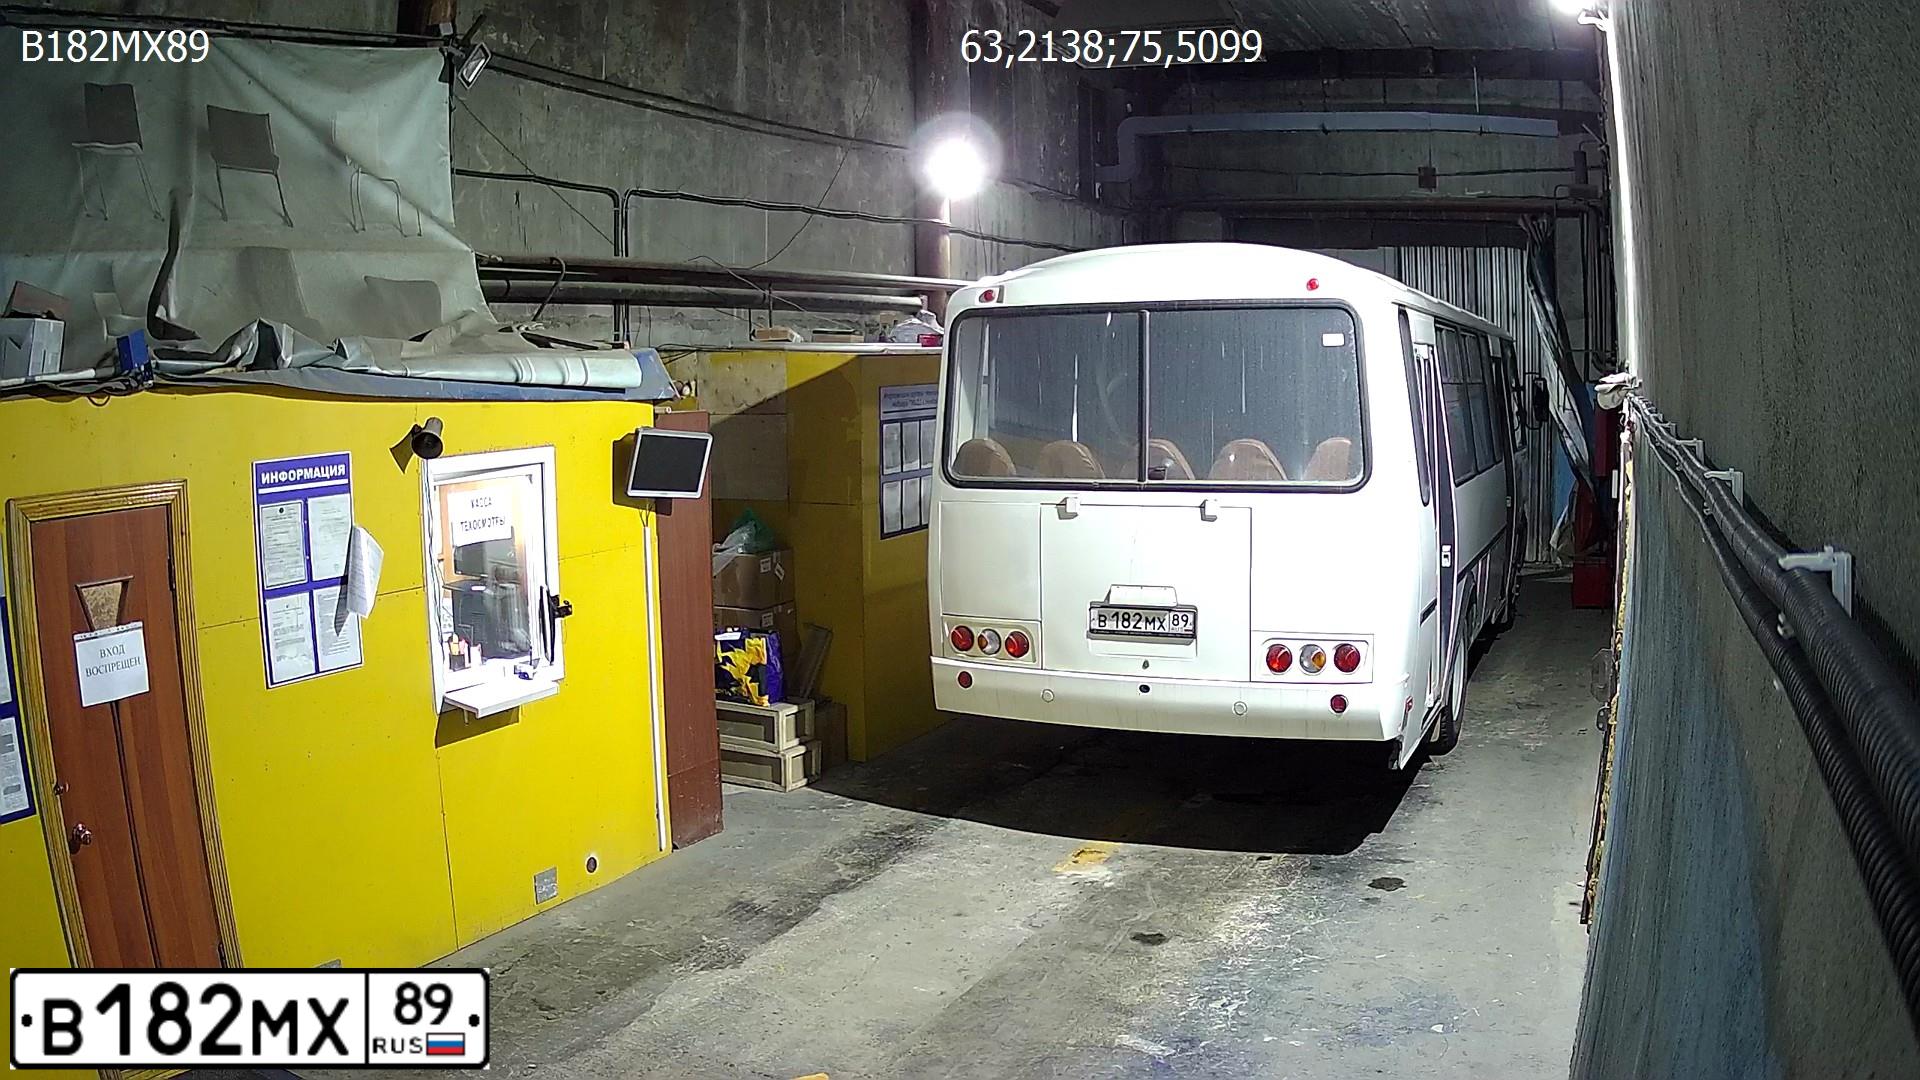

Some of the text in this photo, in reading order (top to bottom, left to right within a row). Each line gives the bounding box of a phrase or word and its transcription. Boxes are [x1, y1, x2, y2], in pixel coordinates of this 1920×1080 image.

[261, 464, 346, 484] ИНФОРМАЦИЯ
[470, 497, 492, 508] КАССА
[1171, 613, 1189, 627] 89
[99, 644, 126, 659] ВХОД
[85, 656, 141, 678] ВОСПРЕЩЕН
